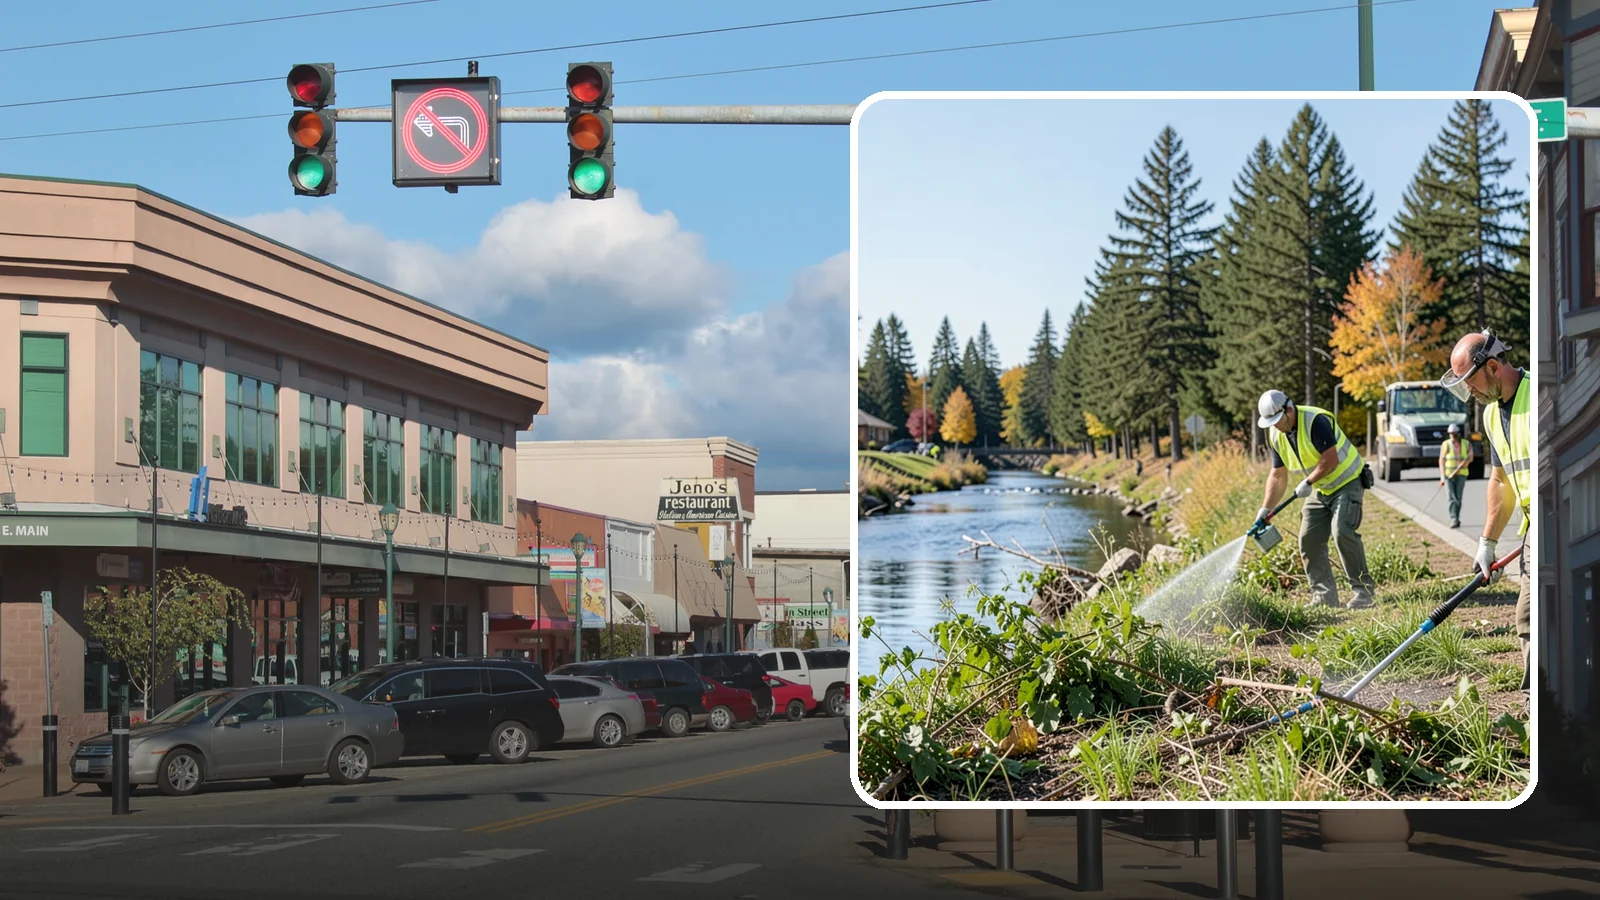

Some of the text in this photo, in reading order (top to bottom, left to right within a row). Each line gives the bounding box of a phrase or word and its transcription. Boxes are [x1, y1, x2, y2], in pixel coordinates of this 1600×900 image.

[670, 480, 727, 494] Jeno's
[665, 497, 731, 509] restaurant
[658, 510, 681, 519] Italian
[686, 510, 714, 519] American
[715, 510, 737, 519] Cuisine
[2, 525, 49, 536] E. MAIN
[798, 607, 828, 617] Street
[790, 619, 823, 627] lass
